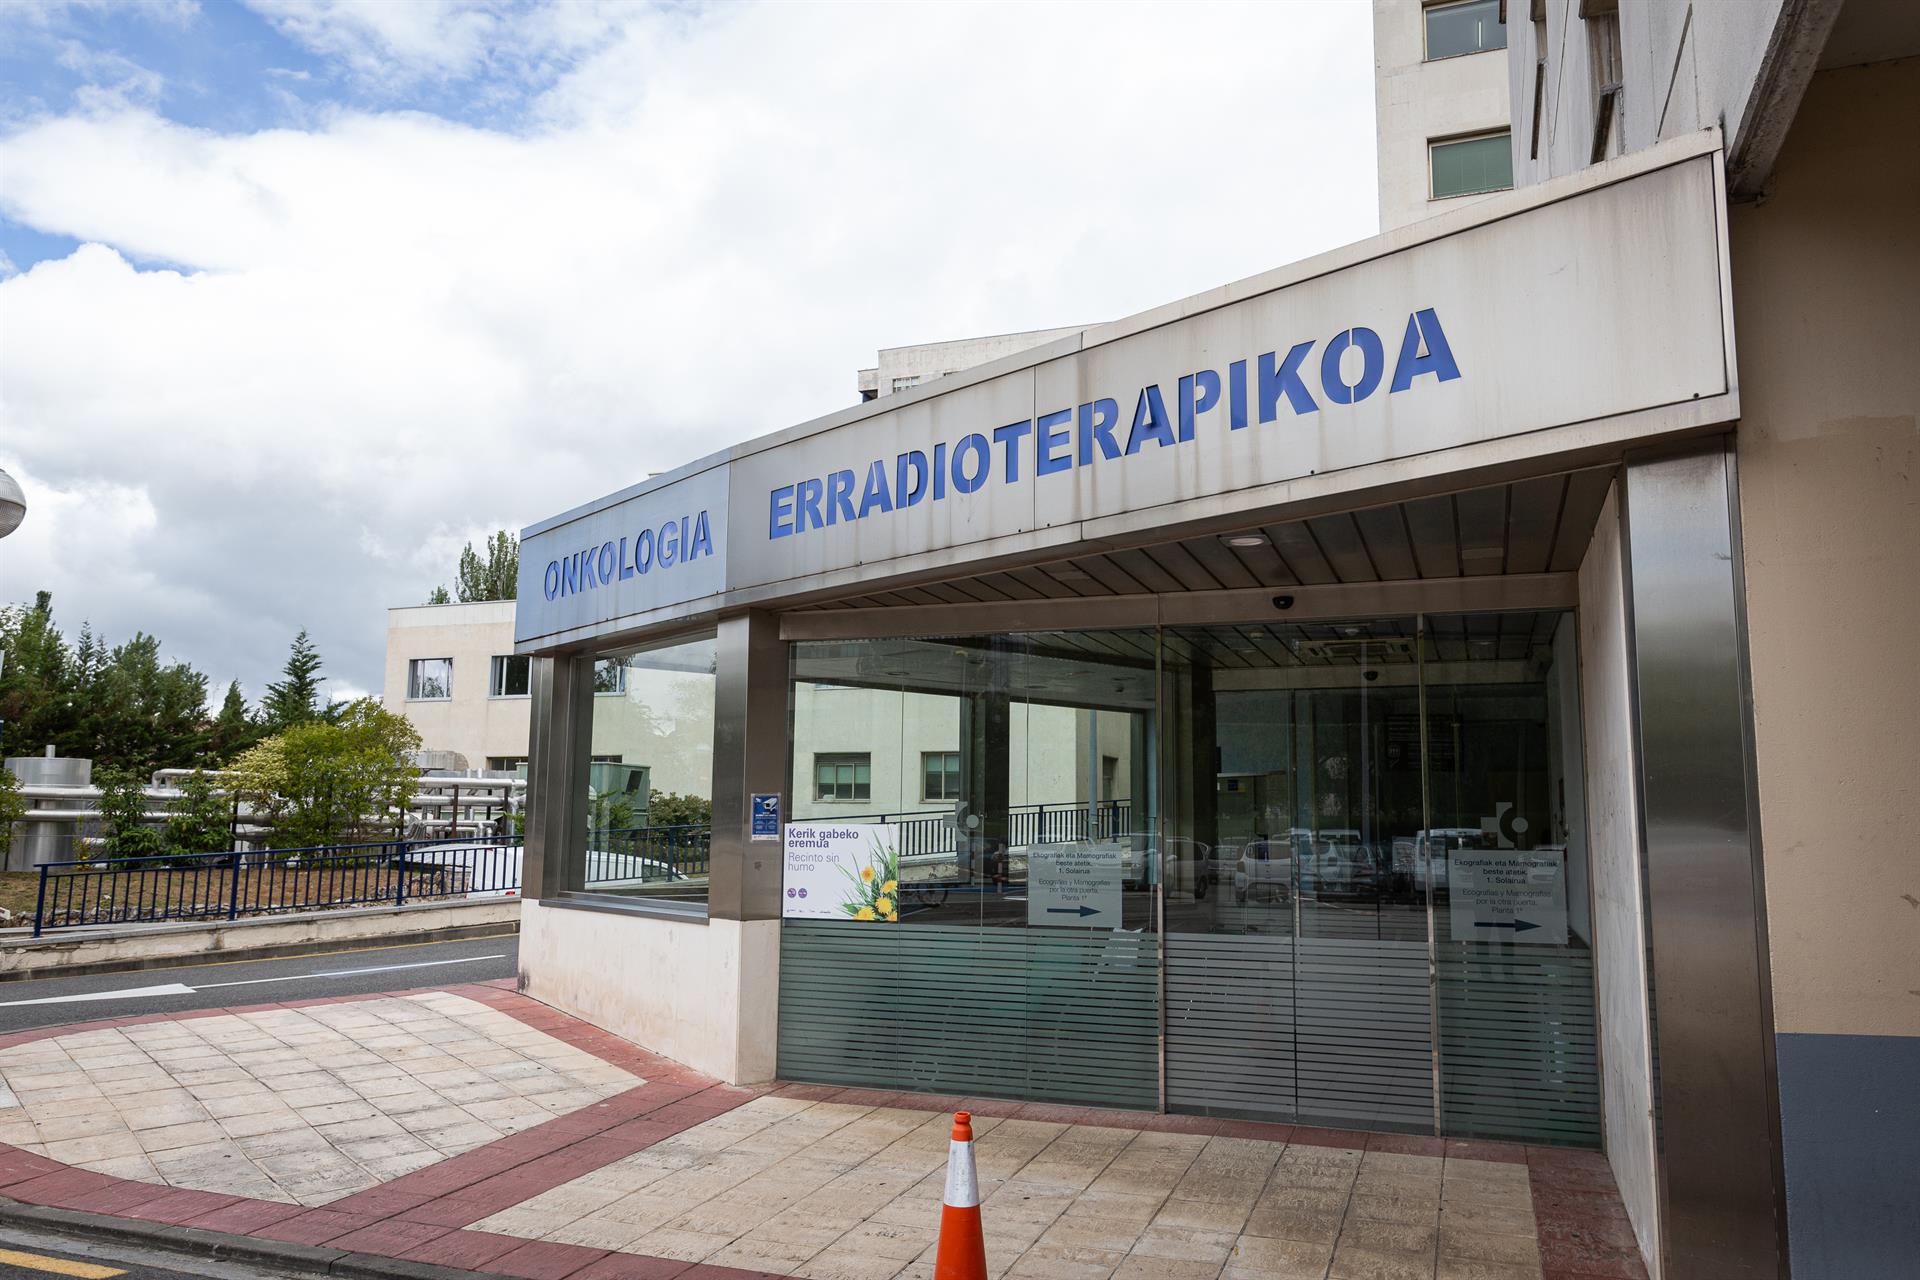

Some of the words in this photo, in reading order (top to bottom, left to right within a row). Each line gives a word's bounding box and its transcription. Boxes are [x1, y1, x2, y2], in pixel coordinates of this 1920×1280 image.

[769, 307, 1462, 540] ERRADIOTERAPIKOA
[543, 510, 714, 601] ONKOLOGIA
[788, 828, 816, 839] Kerik
[819, 828, 859, 840] gabeko
[788, 839, 830, 848] eremua
[788, 852, 823, 862] Recinto
[826, 853, 840, 862] sin
[788, 862, 815, 872] humo
[1454, 859, 1493, 867] Ekografiak
[1508, 859, 1558, 868] Mamografiak
[1476, 898, 1488, 906] por
